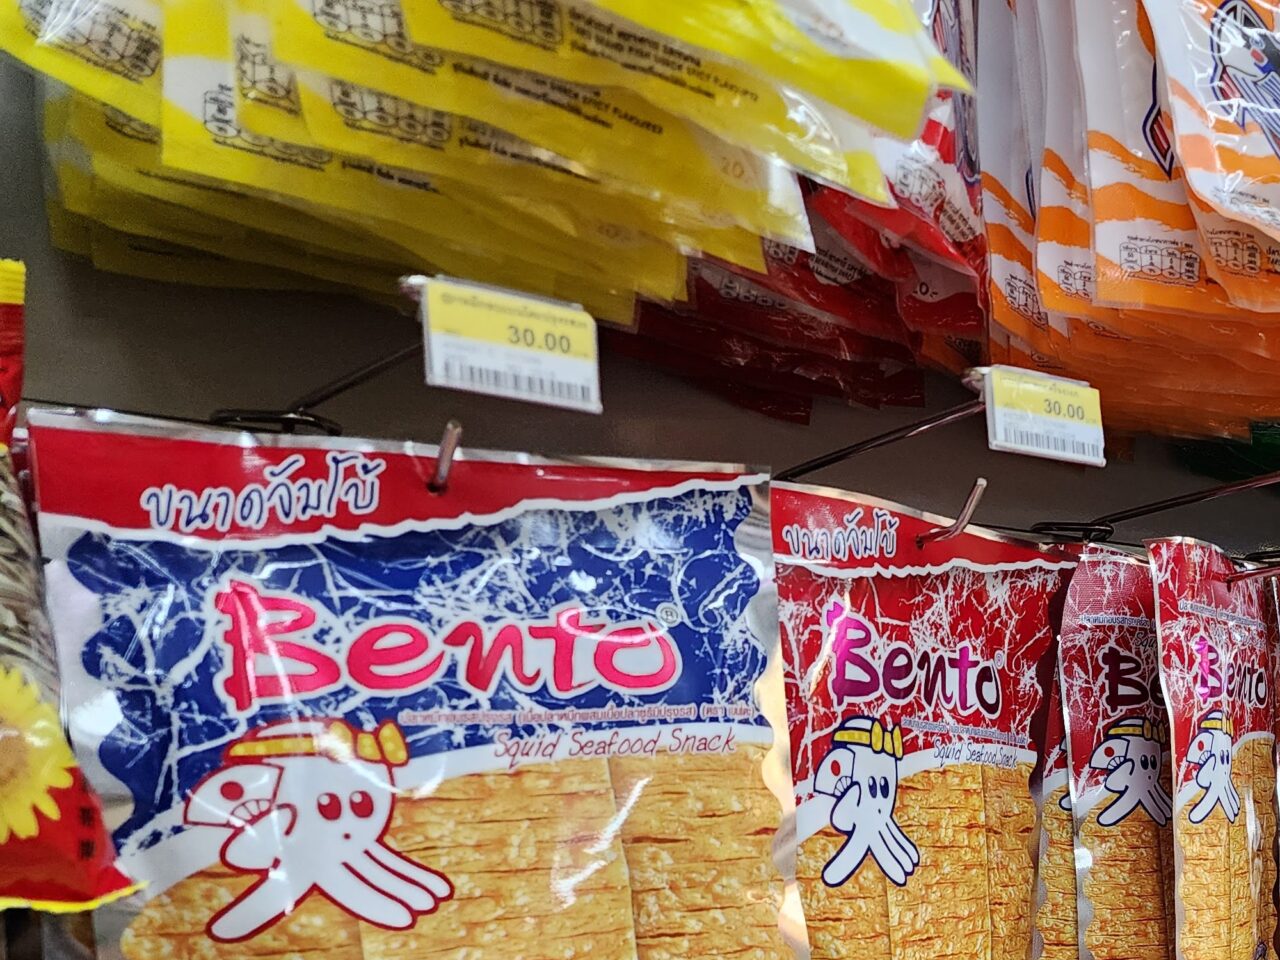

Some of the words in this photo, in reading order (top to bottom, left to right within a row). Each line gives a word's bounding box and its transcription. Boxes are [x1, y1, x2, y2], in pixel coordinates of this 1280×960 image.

[507, 324, 571, 354] 30.00
[1043, 398, 1086, 421] 30.00
[142, 451, 384, 531] ขนาดจัมโบ้
[214, 576, 684, 714] Bento
[825, 599, 1001, 718] Bento
[1192, 633, 1268, 709] Bento
[494, 730, 562, 770] Squid
[566, 729, 664, 757] Seafood
[668, 726, 737, 754] Snack
